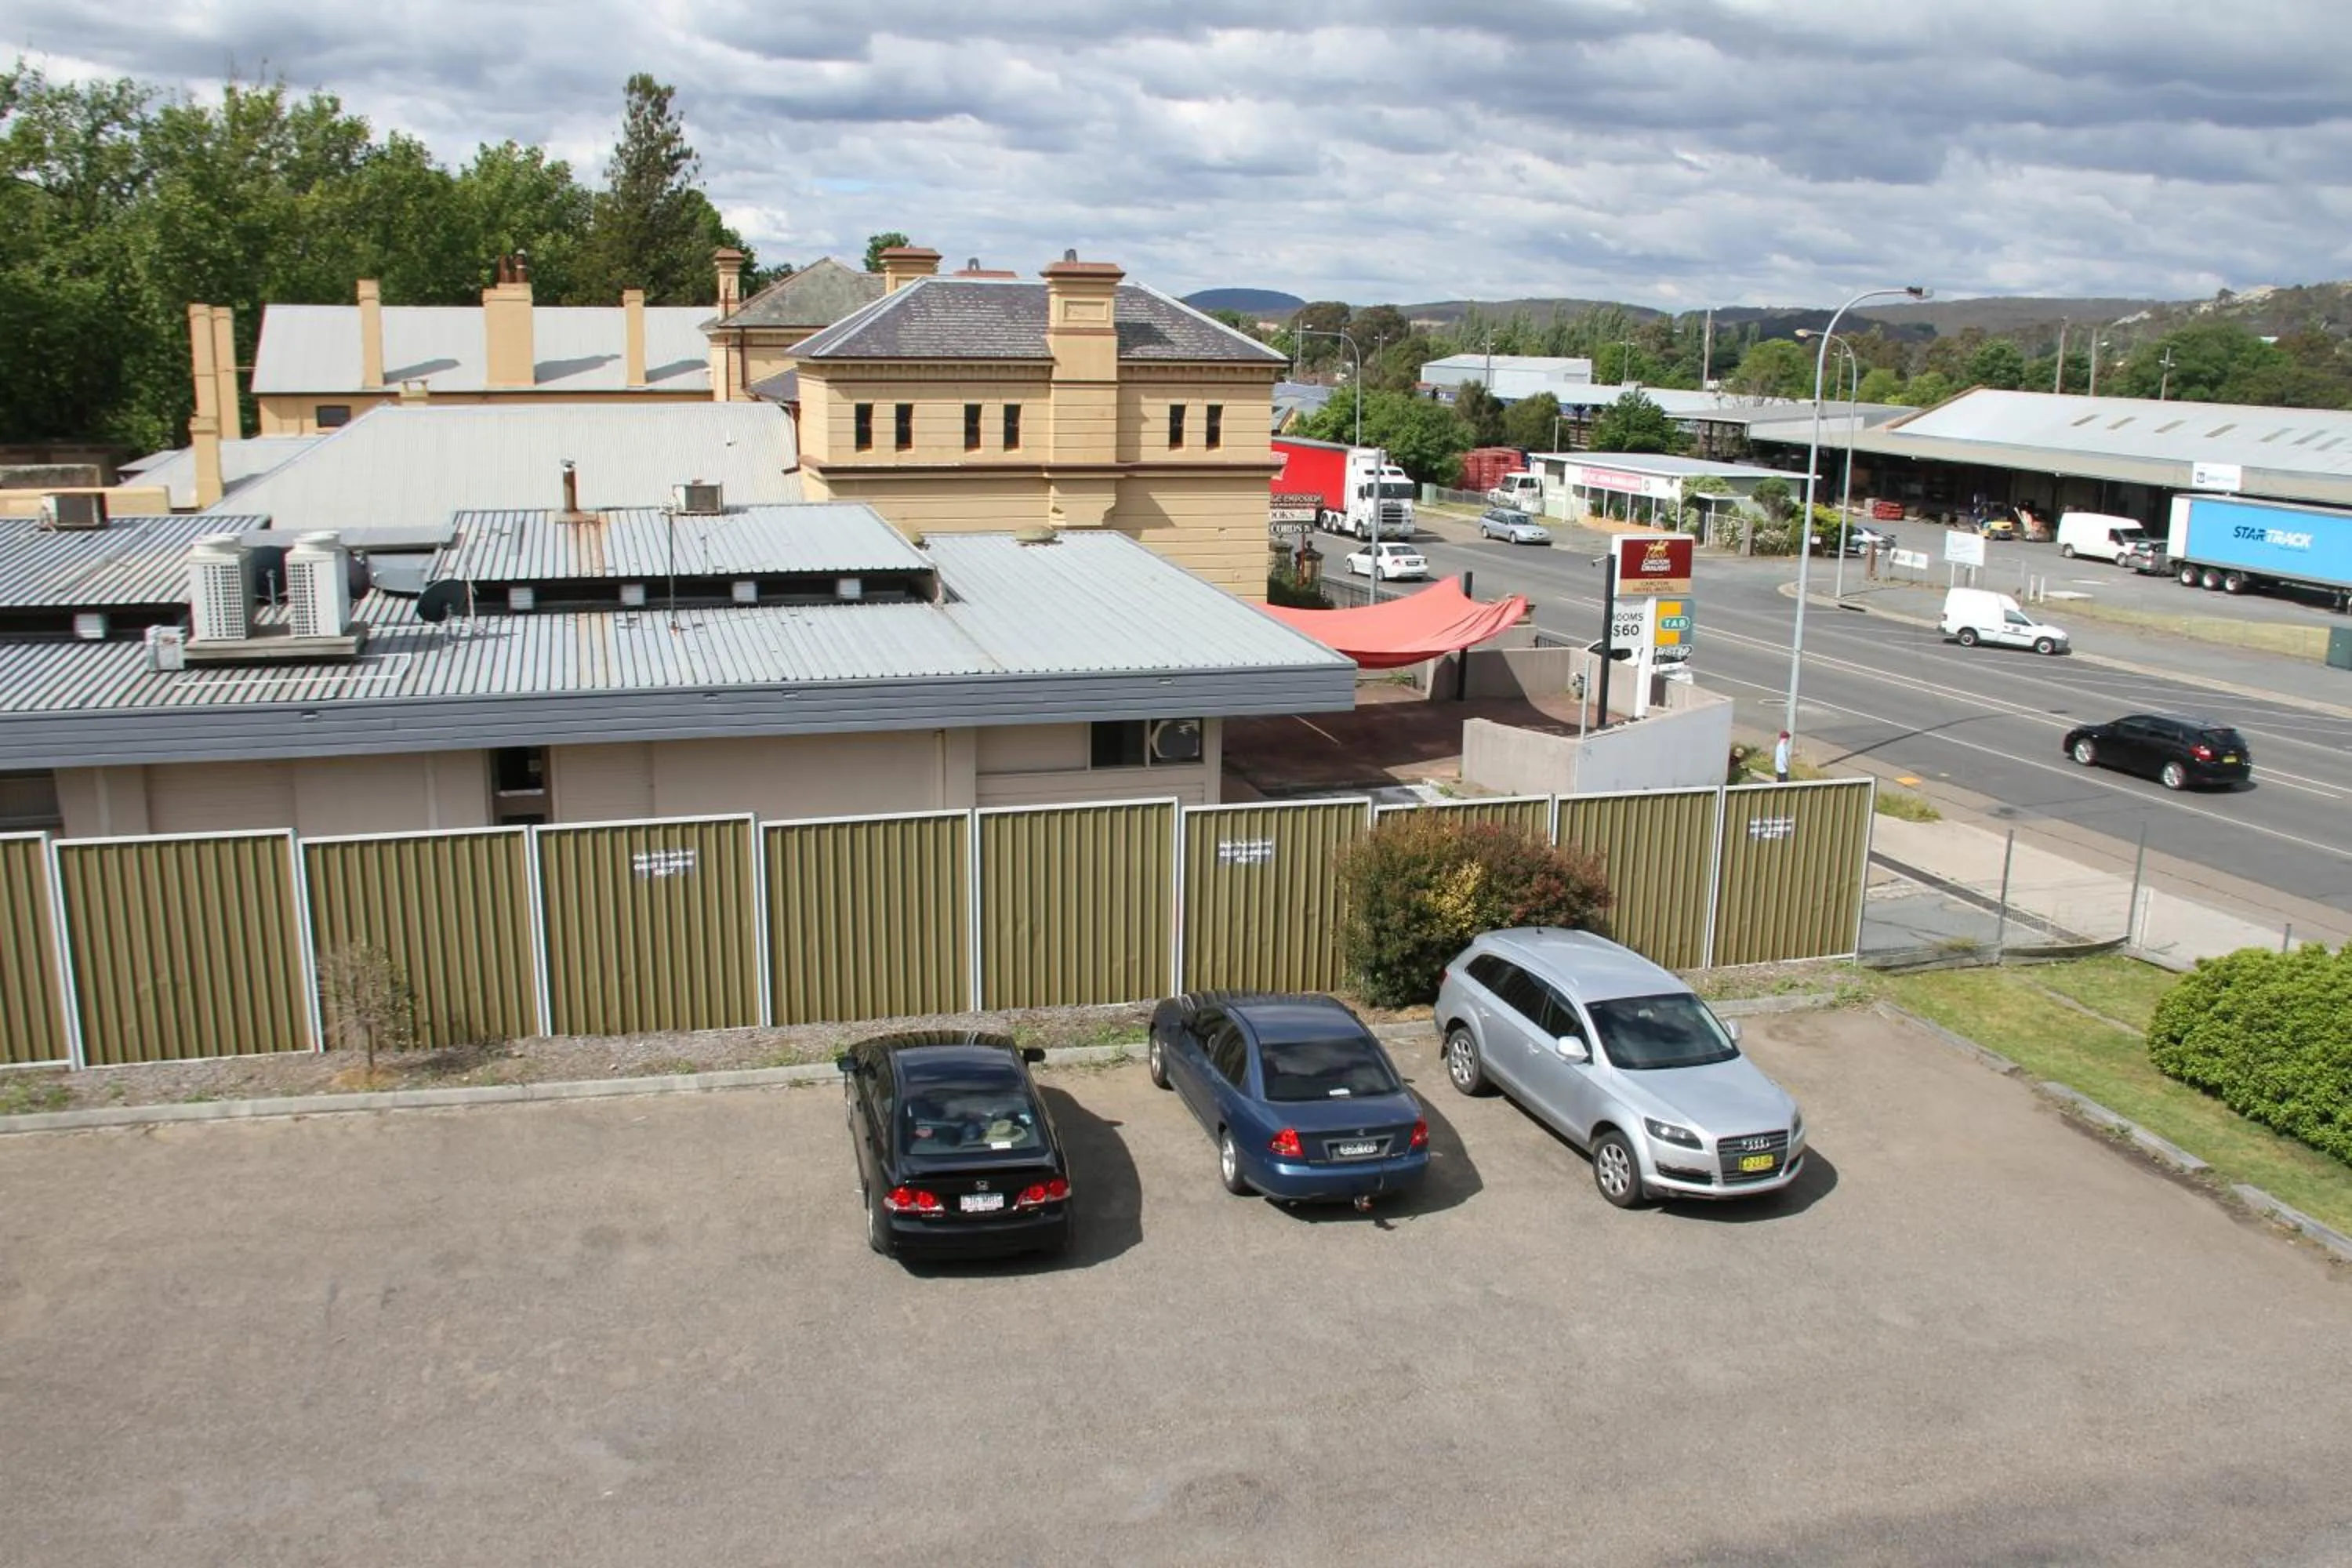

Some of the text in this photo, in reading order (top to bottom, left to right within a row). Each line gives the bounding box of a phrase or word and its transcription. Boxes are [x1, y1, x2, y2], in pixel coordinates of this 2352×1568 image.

[2233, 525, 2313, 548] STARTRACK
[1664, 619, 1687, 628] TAB
[1613, 624, 1639, 637] $60
